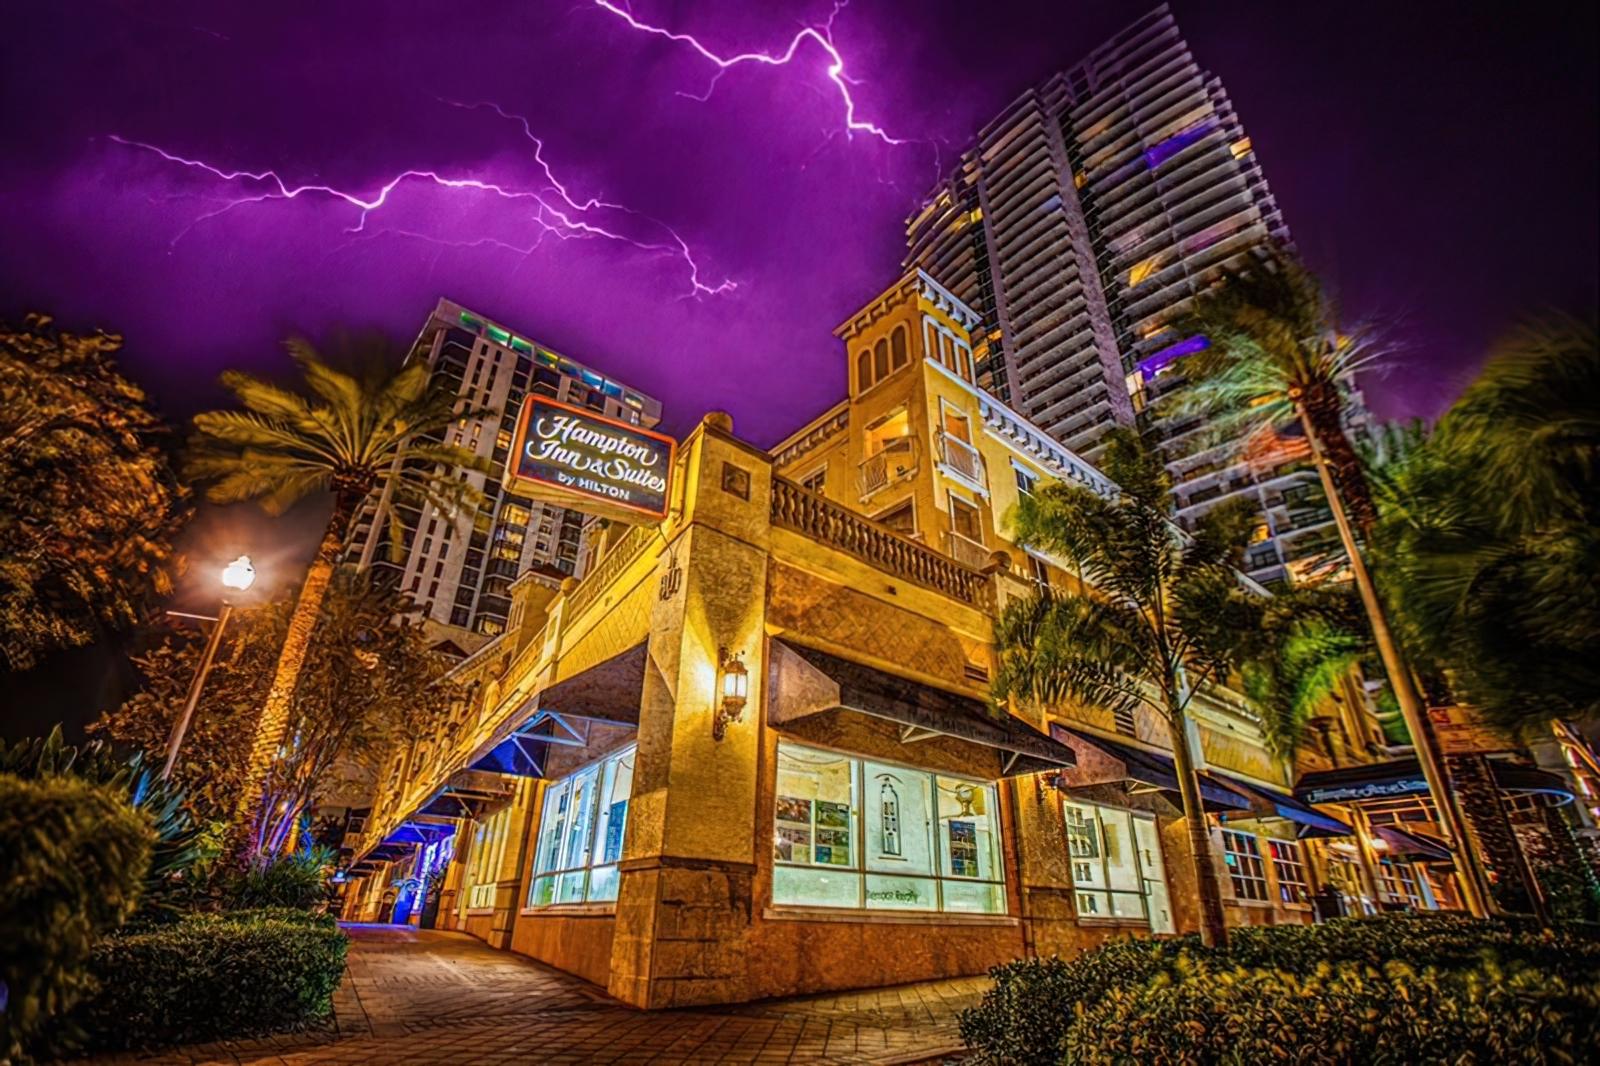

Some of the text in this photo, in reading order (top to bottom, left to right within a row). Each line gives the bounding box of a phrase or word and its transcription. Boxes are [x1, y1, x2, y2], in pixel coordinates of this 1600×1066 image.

[536, 416, 658, 466] Hampton
[526, 440, 667, 493] Inn & Suites
[558, 472, 630, 501] by HILTON
